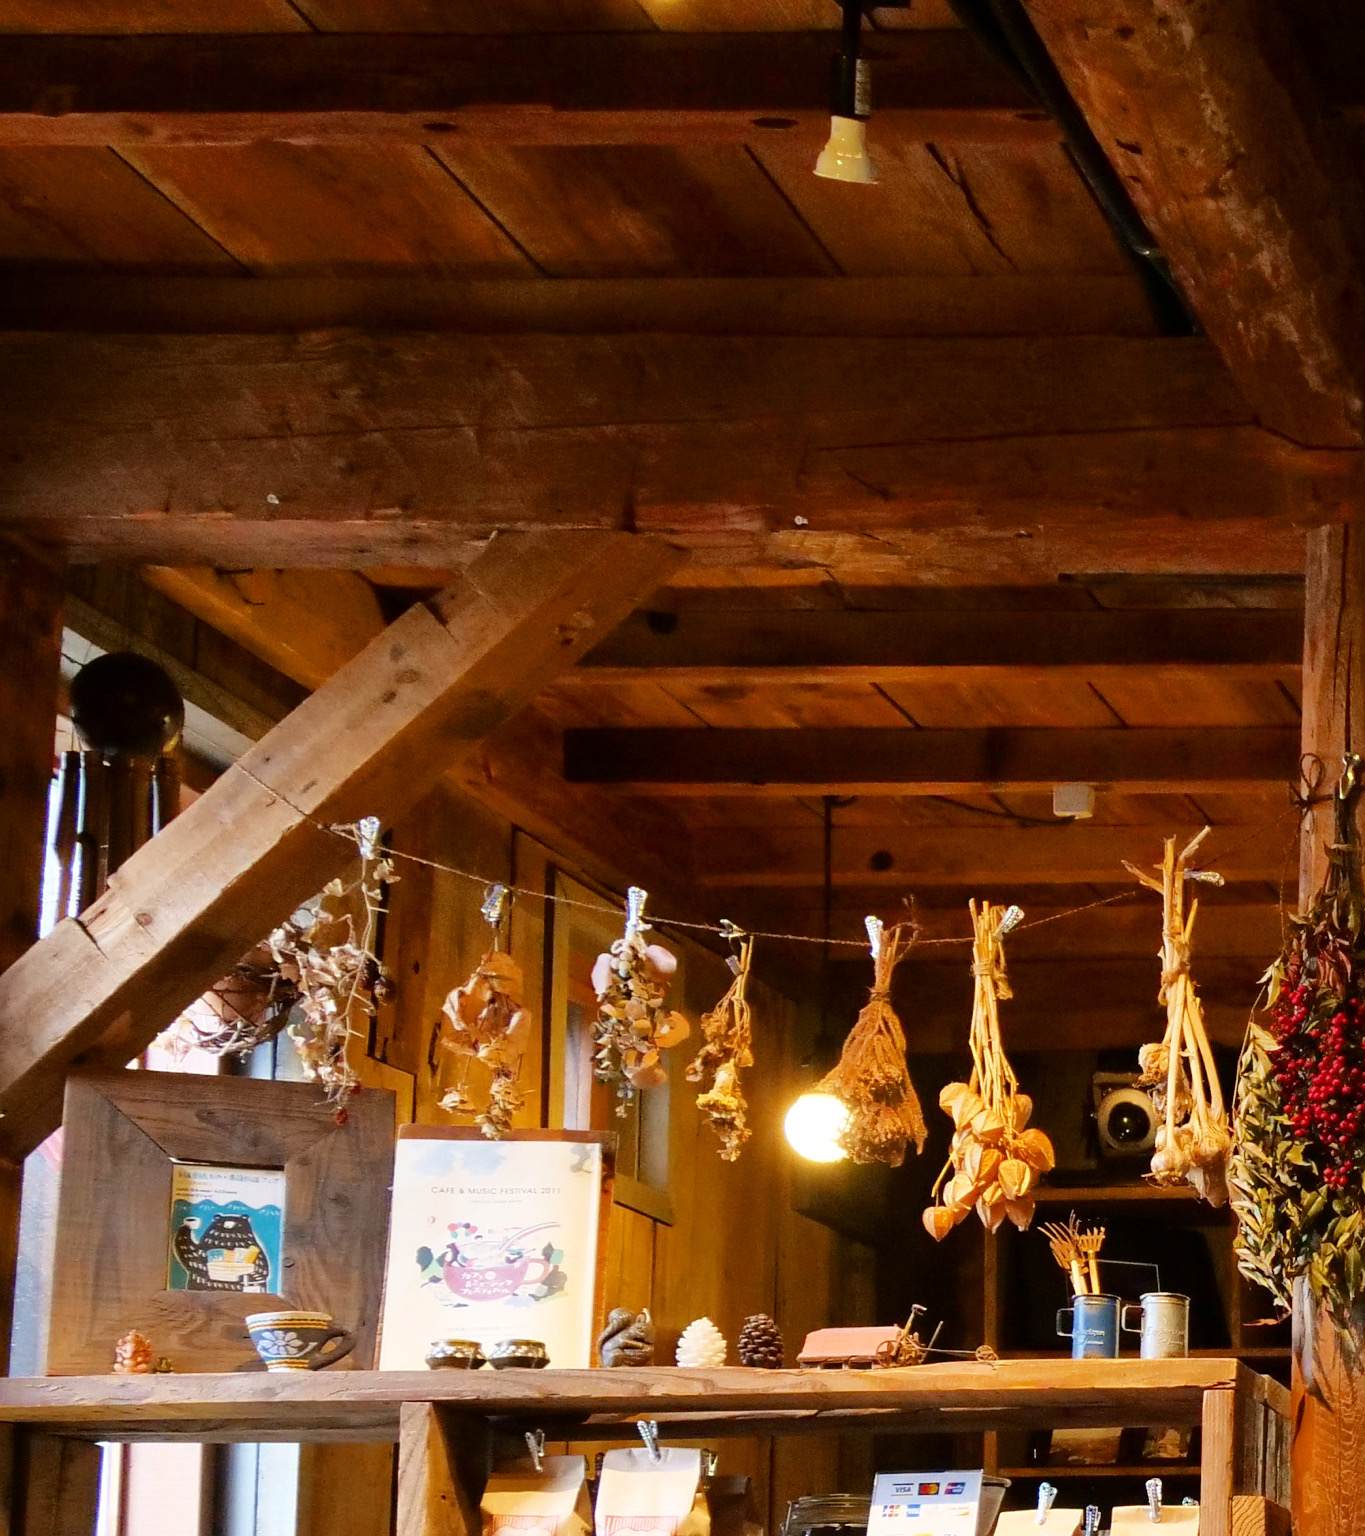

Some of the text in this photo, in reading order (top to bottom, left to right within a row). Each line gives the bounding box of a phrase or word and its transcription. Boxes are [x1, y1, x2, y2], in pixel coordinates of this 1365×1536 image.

[430, 1186, 456, 1194] CAFE
[467, 1187, 498, 1195] MUSIC
[499, 1187, 538, 1195] FESTIVAL
